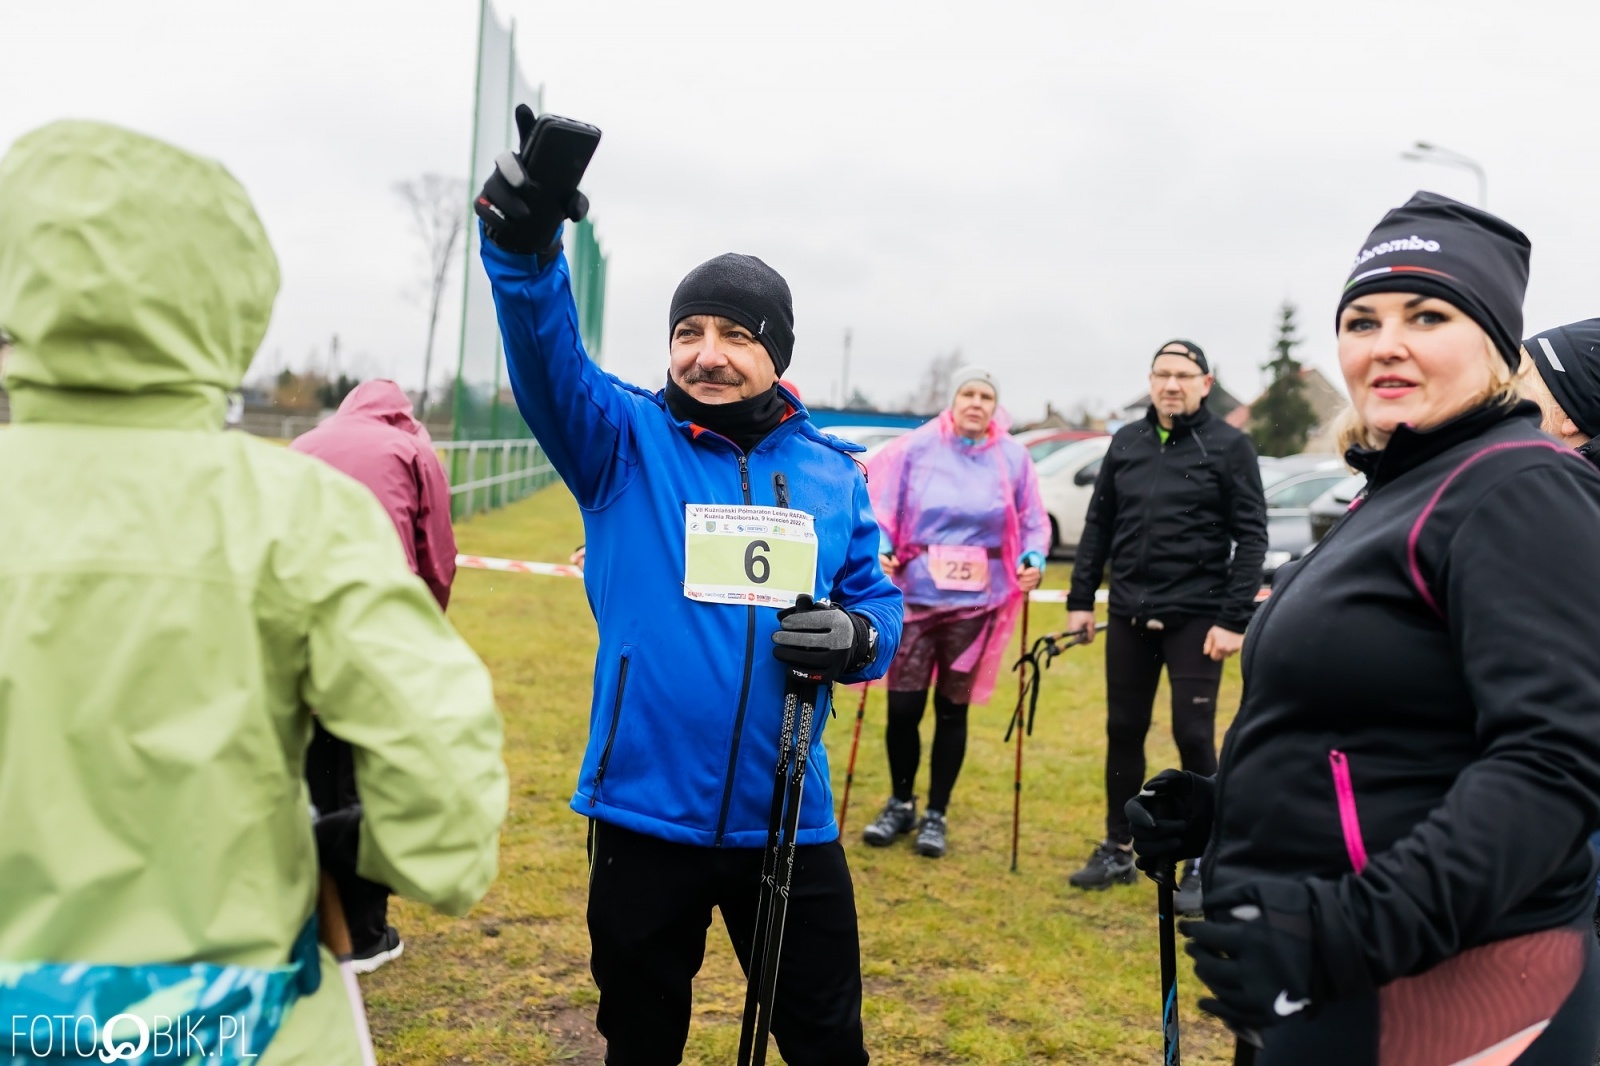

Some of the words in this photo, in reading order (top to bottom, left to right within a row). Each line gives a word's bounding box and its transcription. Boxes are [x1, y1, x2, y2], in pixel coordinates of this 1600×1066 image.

[766, 516, 790, 524] kwiecień
[790, 518, 802, 526] 2022
[772, 510, 788, 518] Leśny
[744, 539, 771, 584] 6
[945, 561, 972, 580] 25
